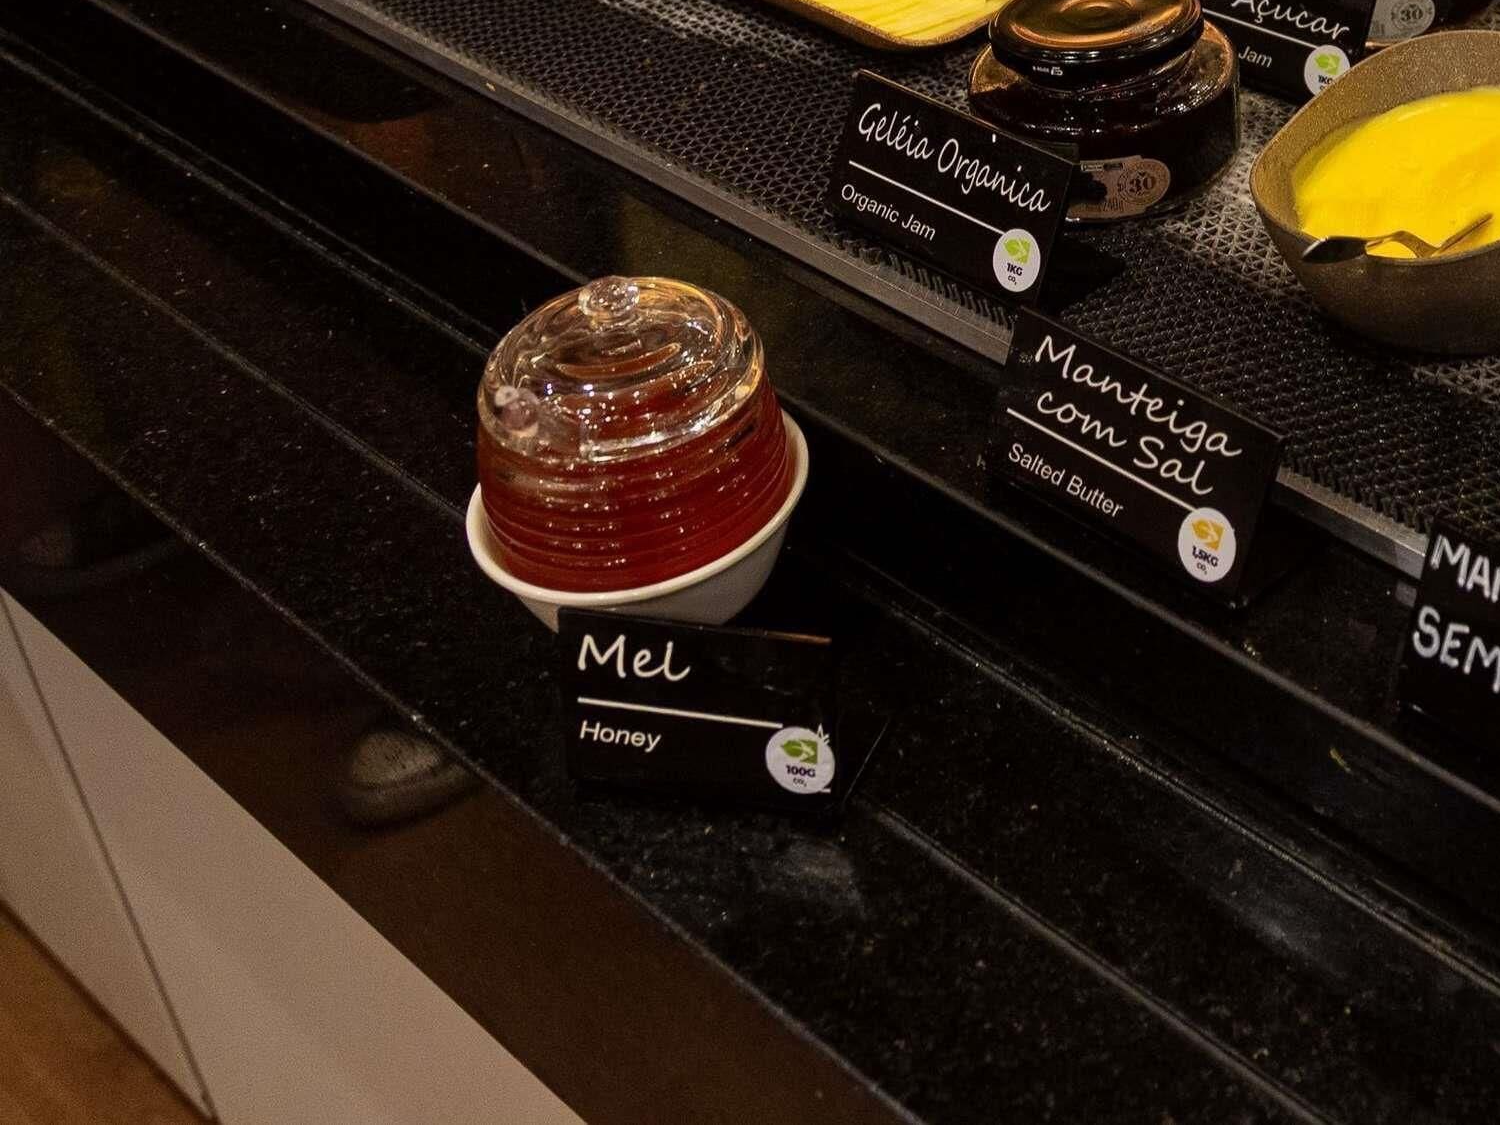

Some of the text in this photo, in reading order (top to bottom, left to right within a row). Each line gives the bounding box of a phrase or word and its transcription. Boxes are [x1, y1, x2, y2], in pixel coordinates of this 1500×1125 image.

[1238, 45, 1273, 69] Jam
[858, 102, 1052, 212] Geléia Organica
[841, 183, 937, 242] Organic Jam
[1006, 262, 1024, 277] 1KG
[1034, 335, 1243, 457] Manteiga
[1036, 391, 1214, 495] com Sal
[1007, 442, 1125, 518] Salted Butter
[577, 633, 691, 682] Mel
[579, 720, 662, 753] Honey
[785, 764, 817, 779] 100G
